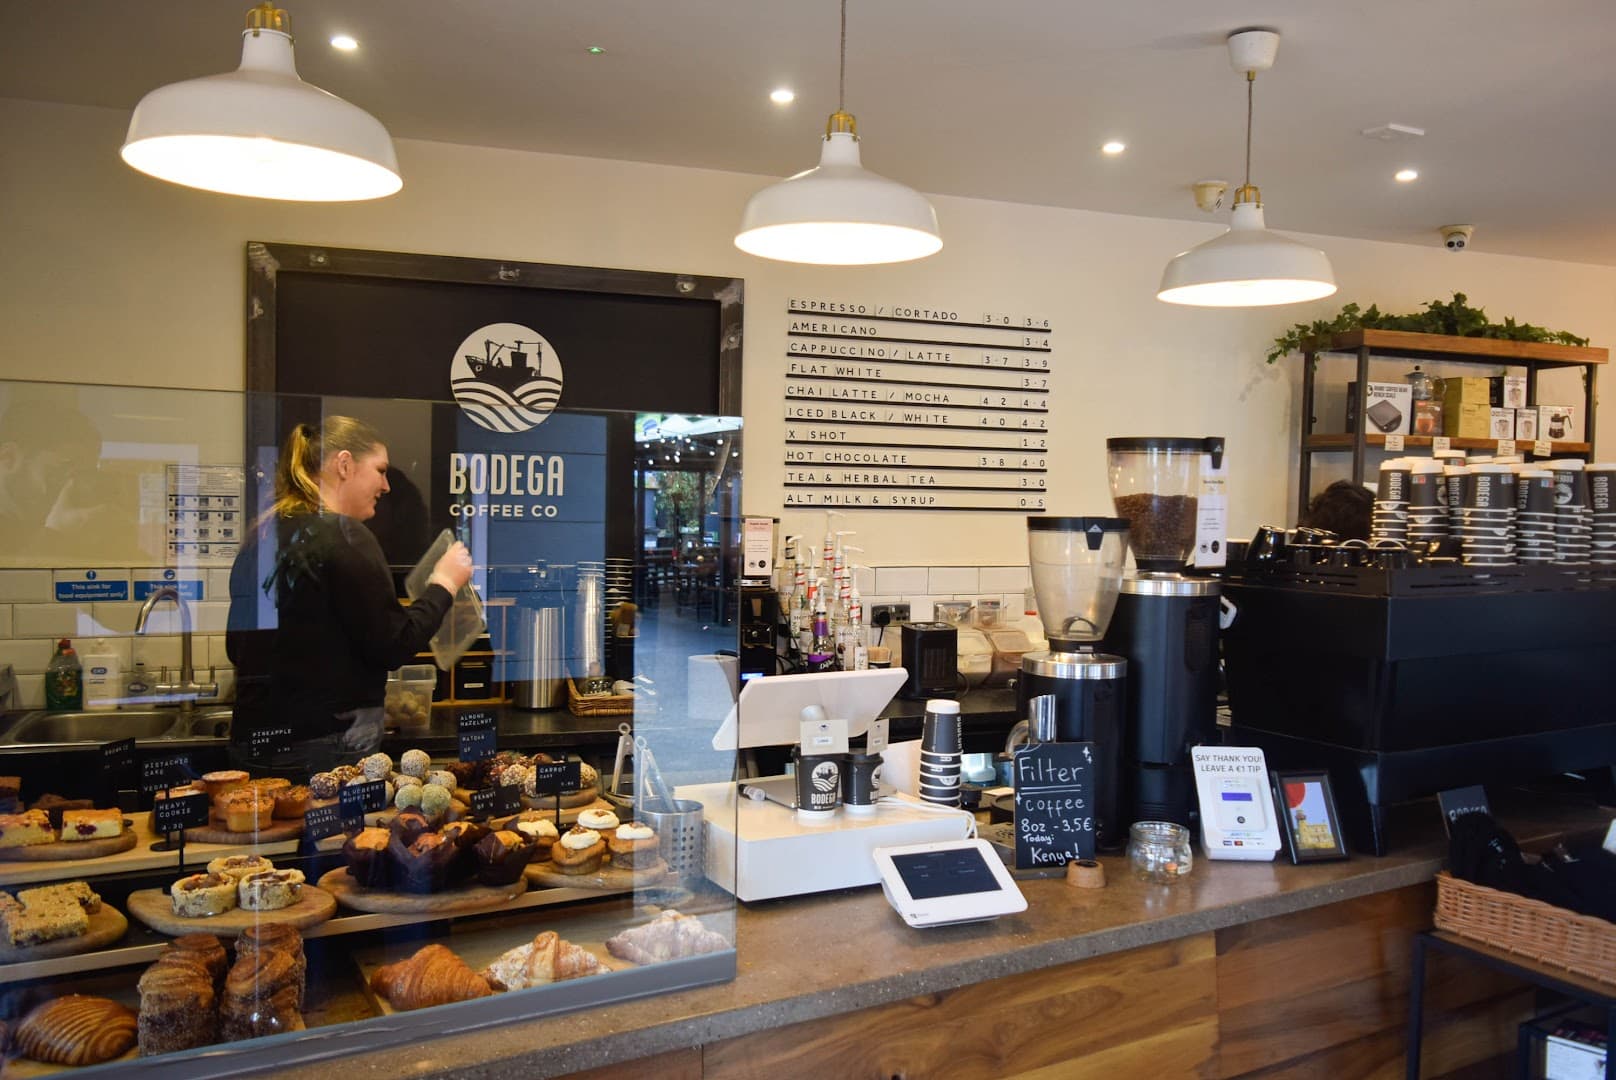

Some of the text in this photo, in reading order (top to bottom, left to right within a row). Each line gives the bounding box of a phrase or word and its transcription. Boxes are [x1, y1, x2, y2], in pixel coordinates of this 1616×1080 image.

[790, 300, 866, 313] ESPRESSO
[895, 308, 958, 320] CORTADO
[792, 322, 876, 335] AMERICANO
[791, 343, 885, 356] CAPPUCCINO
[908, 351, 951, 361] LATTE
[791, 364, 827, 373] FLAT
[836, 367, 881, 377] WHITE
[788, 386, 822, 395] CHAI
[832, 389, 877, 398] LATTE
[906, 393, 949, 402] MOCHA
[789, 408, 824, 417] ICED
[832, 410, 876, 419] BLACK
[905, 414, 948, 423] WHITE
[789, 430, 795, 438] X
[810, 431, 846, 440] SHOT
[787, 452, 814, 460] HOT
[825, 453, 908, 463] CHOCOLATE
[450, 452, 564, 496] BODEGA
[788, 473, 815, 481] TEA
[844, 474, 897, 483] HERBAL
[911, 476, 935, 484] TEA
[1476, 476, 1490, 507] BODEGA
[1594, 476, 1608, 508] BODEGA
[892, 496, 935, 504] SYRUP
[449, 504, 558, 517] COFFEE CO
[460, 718, 492, 726] HAZELNUT
[252, 728, 292, 736] PINEAPPLE
[145, 758, 188, 768] PISTACHIO
[1020, 756, 1084, 782] Filter
[160, 800, 186, 810] HEAVY
[1026, 799, 1085, 818] coffee
[160, 808, 191, 817] COOKIE
[1021, 818, 1046, 832] 8oz
[1062, 818, 1092, 832] 3.5€
[1023, 833, 1054, 844] Today:
[1031, 842, 1080, 865] Kenya!
